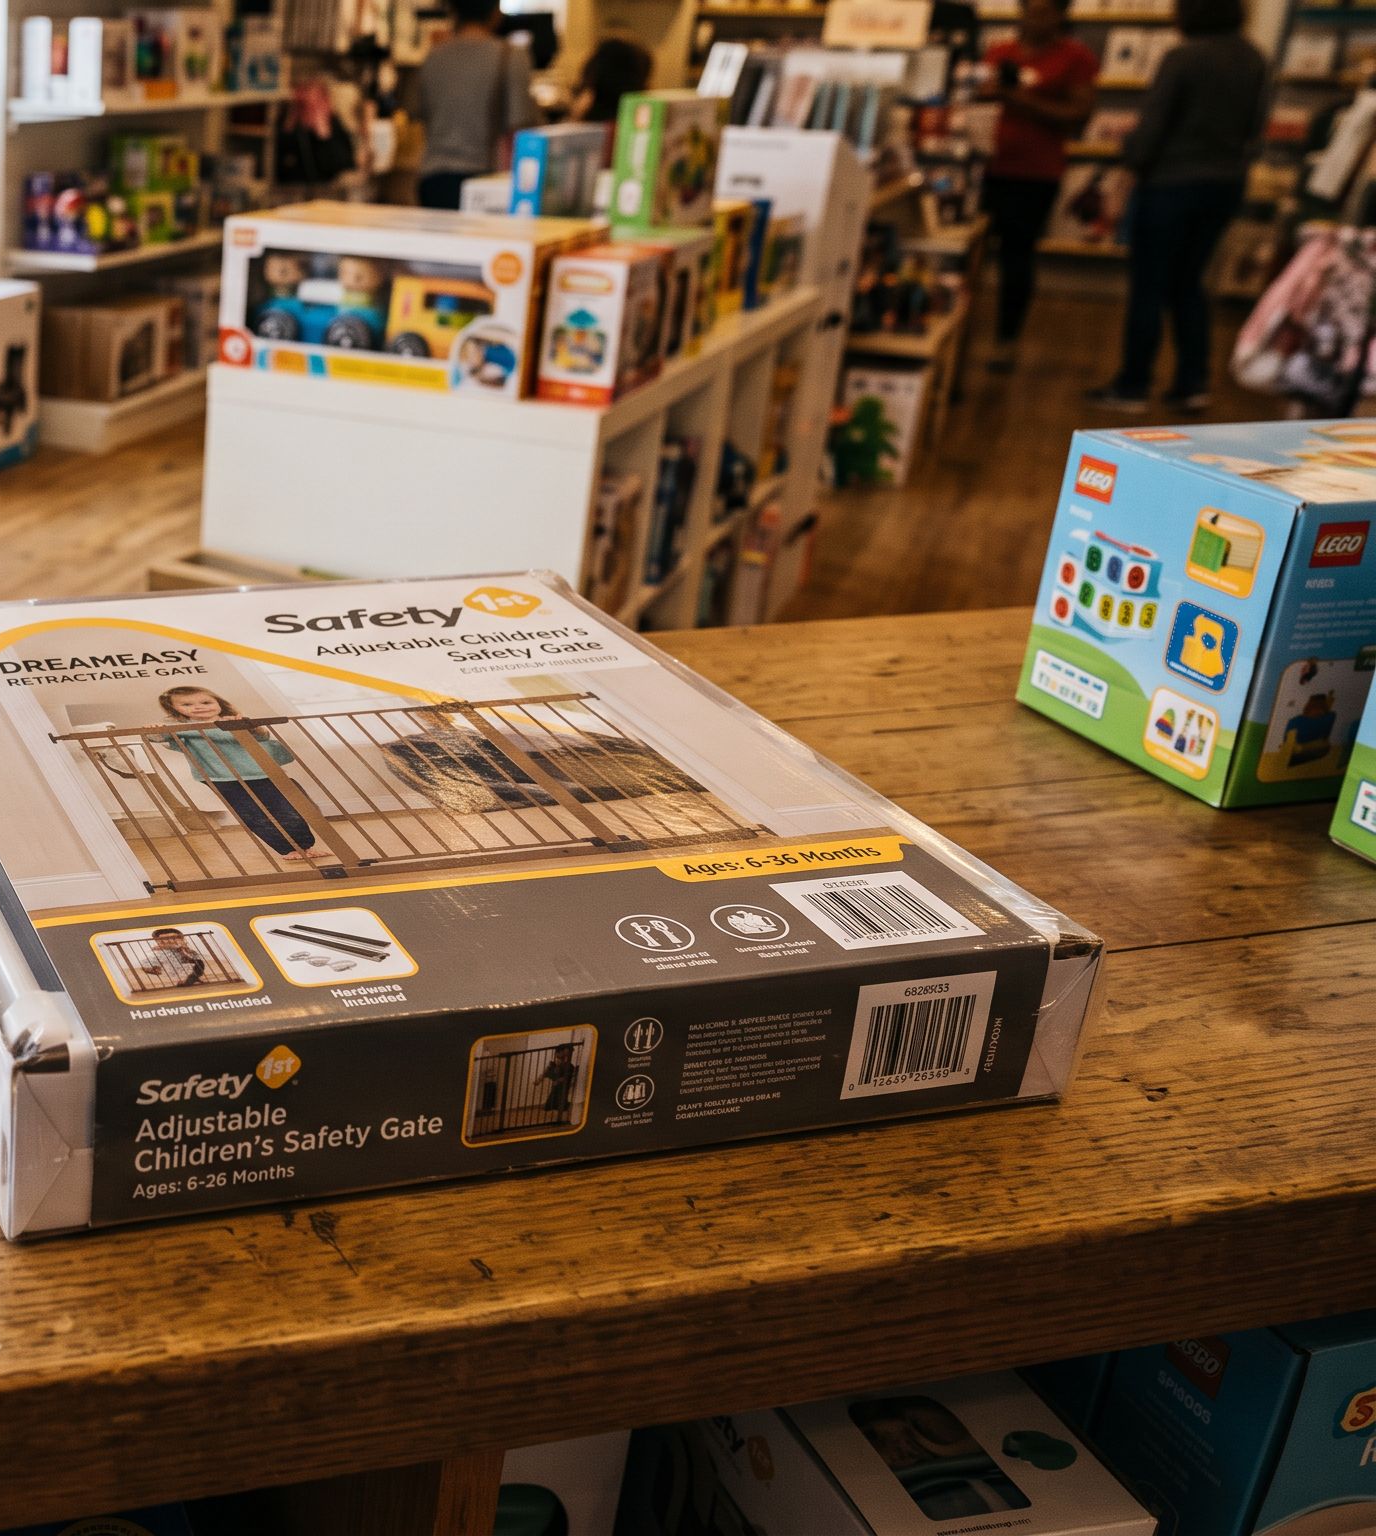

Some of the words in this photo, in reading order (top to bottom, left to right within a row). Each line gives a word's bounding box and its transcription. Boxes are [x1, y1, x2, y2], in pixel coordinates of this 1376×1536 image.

[1318, 535, 1363, 554] LEGO
[264, 606, 464, 634] Safety
[471, 593, 532, 612] 1st
[316, 636, 454, 657] Adjustable
[460, 627, 590, 646] Children's
[447, 646, 533, 663] Safety
[540, 639, 604, 654] Gate
[6, 669, 151, 687] RETRACTABLE
[155, 665, 209, 677] GATE
[682, 857, 745, 877] Ages:
[747, 853, 798, 868] 6-36
[799, 845, 882, 863] Months
[129, 1003, 205, 1021] Hardware
[207, 995, 273, 1012] Included
[135, 1073, 253, 1105] Safety
[259, 1056, 297, 1080] 1st
[134, 1103, 288, 1143] Adjustable
[134, 1135, 275, 1173] Children's
[283, 1123, 372, 1153] Safety
[380, 1115, 444, 1141] Gate
[132, 1180, 182, 1199] Ages:
[186, 1173, 228, 1192] 6-26
[232, 1164, 296, 1186] Months
